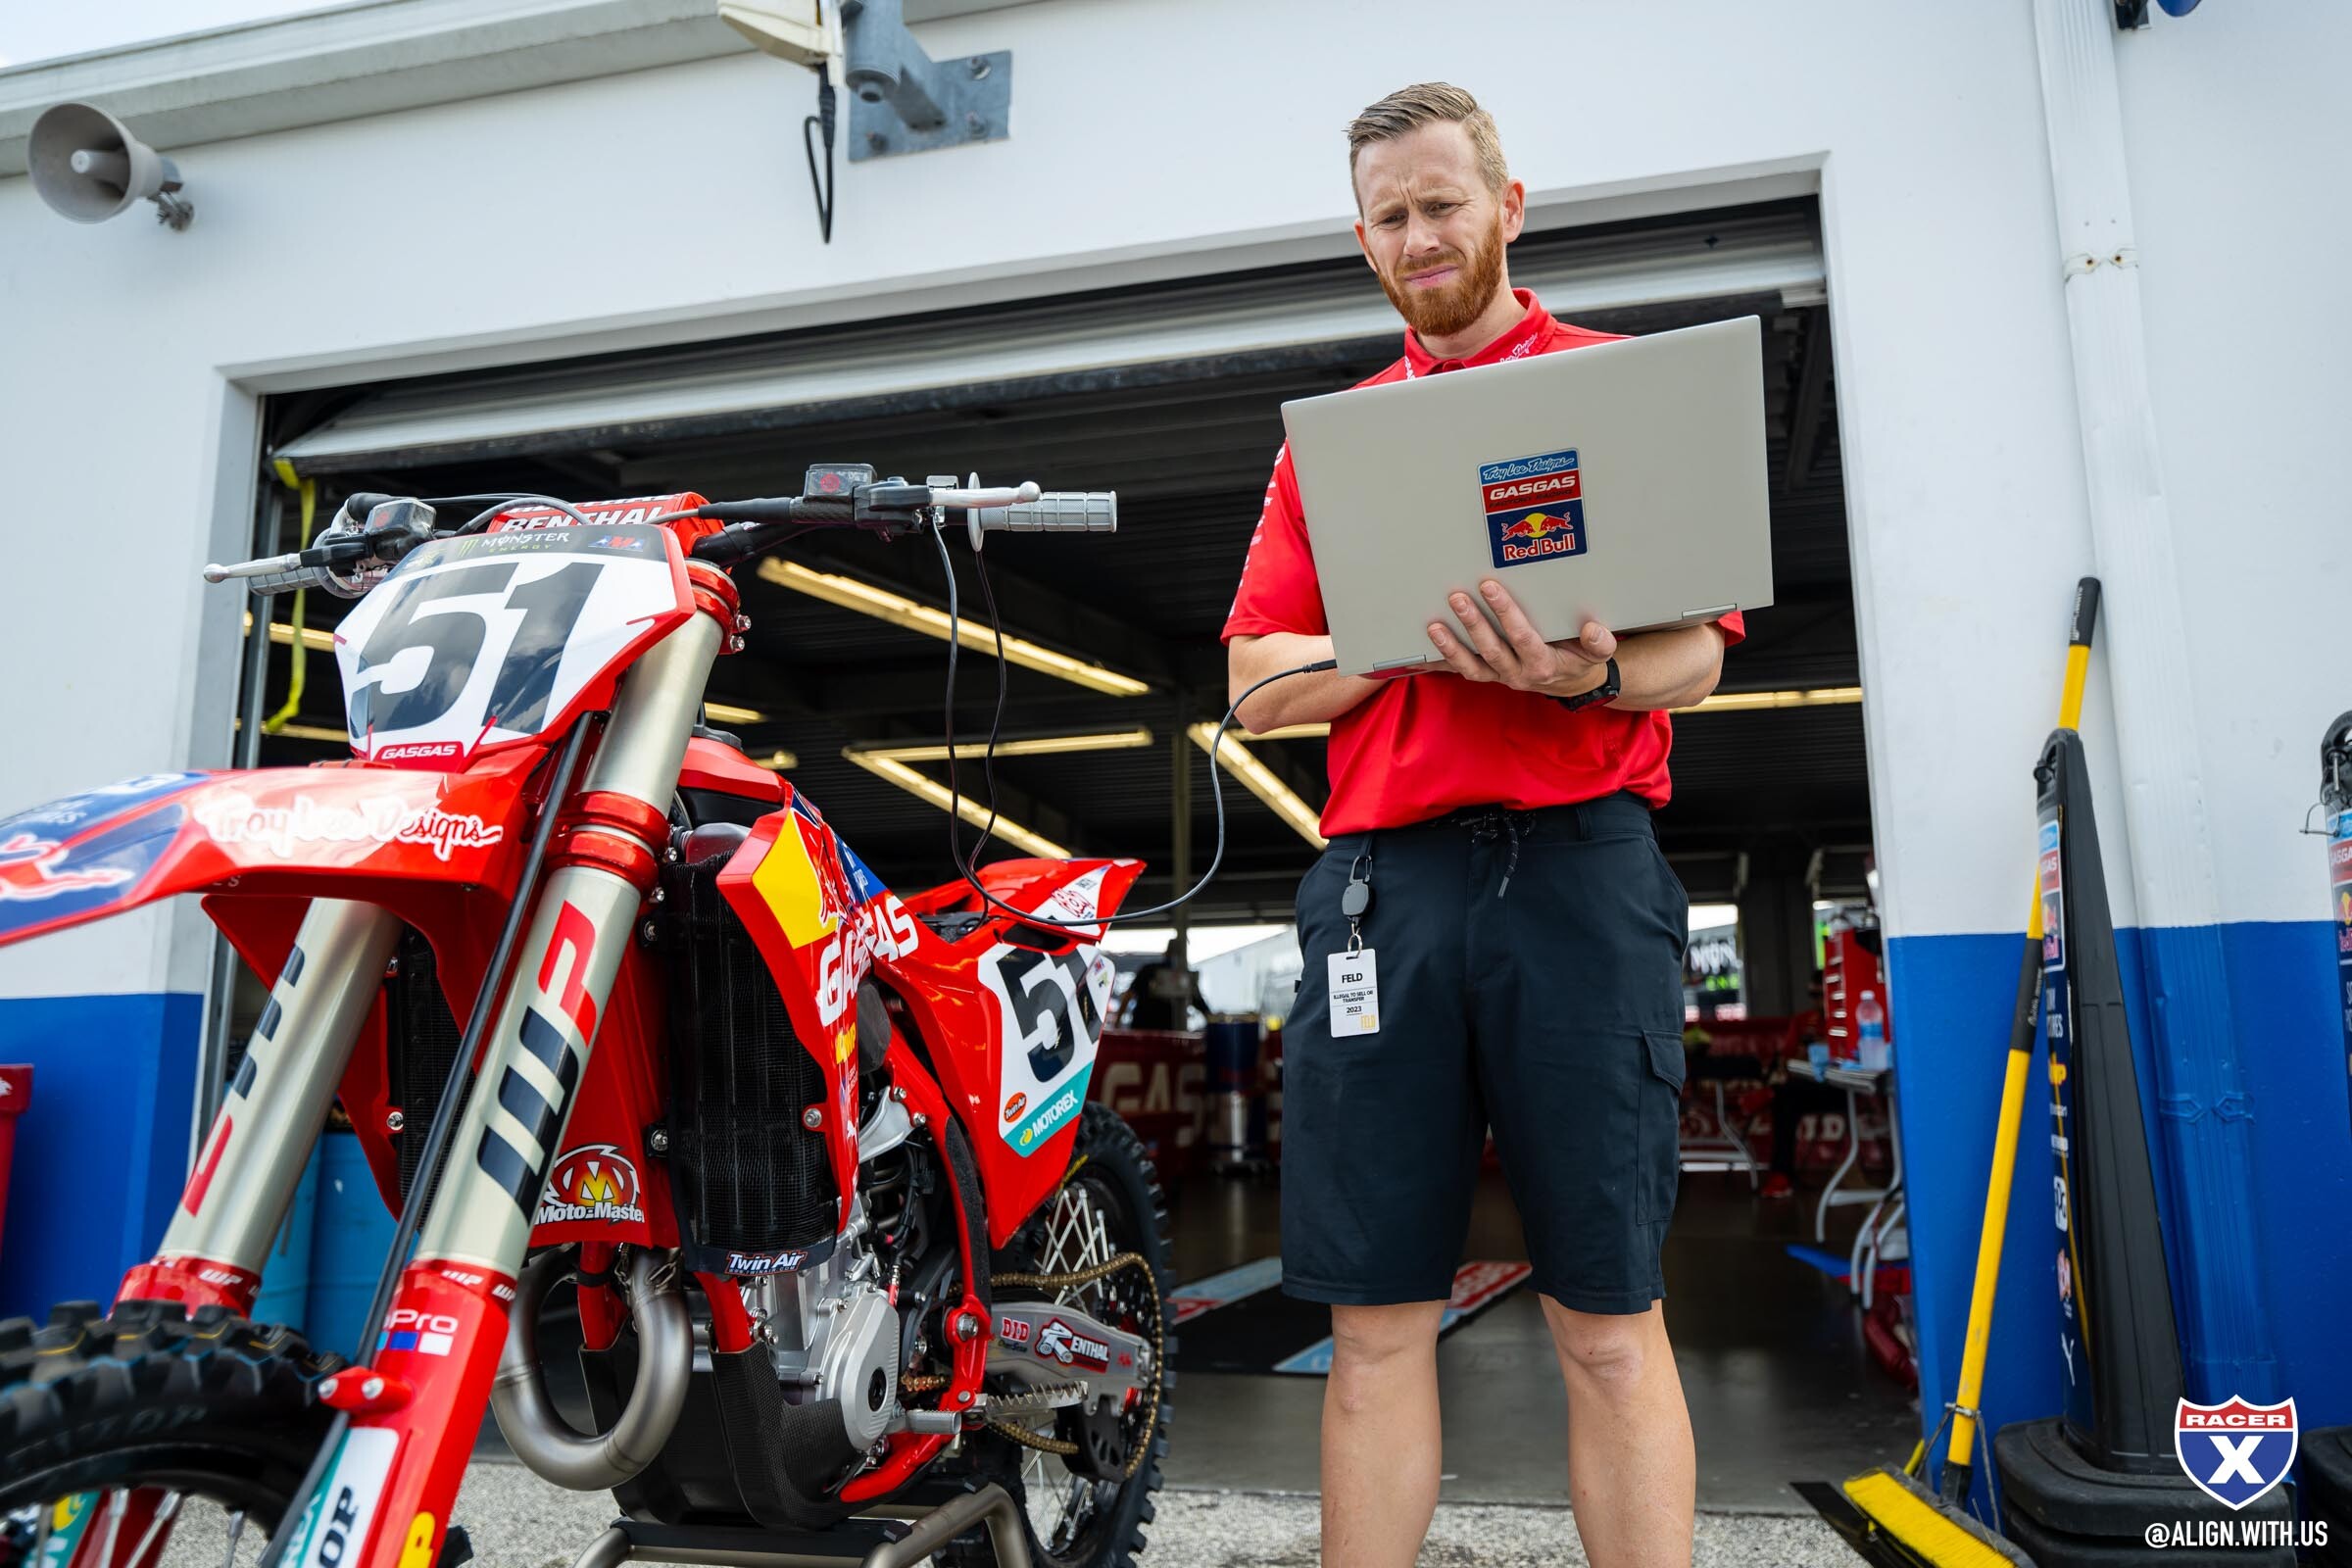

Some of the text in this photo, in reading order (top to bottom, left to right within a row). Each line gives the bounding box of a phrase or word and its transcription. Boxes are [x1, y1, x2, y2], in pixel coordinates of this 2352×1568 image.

[1507, 464, 1529, 476] Lee
[1490, 476, 1576, 501] GASGAS
[481, 531, 571, 547] MONSTER
[1503, 533, 1576, 561] Red Bull
[350, 562, 605, 738] 51
[381, 744, 457, 760] GASGAS
[1342, 973, 1363, 983] FELD
[1032, 1090, 1079, 1137] MOTOREX
[730, 1252, 805, 1271] Twin Air
[384, 1308, 459, 1334] Pro
